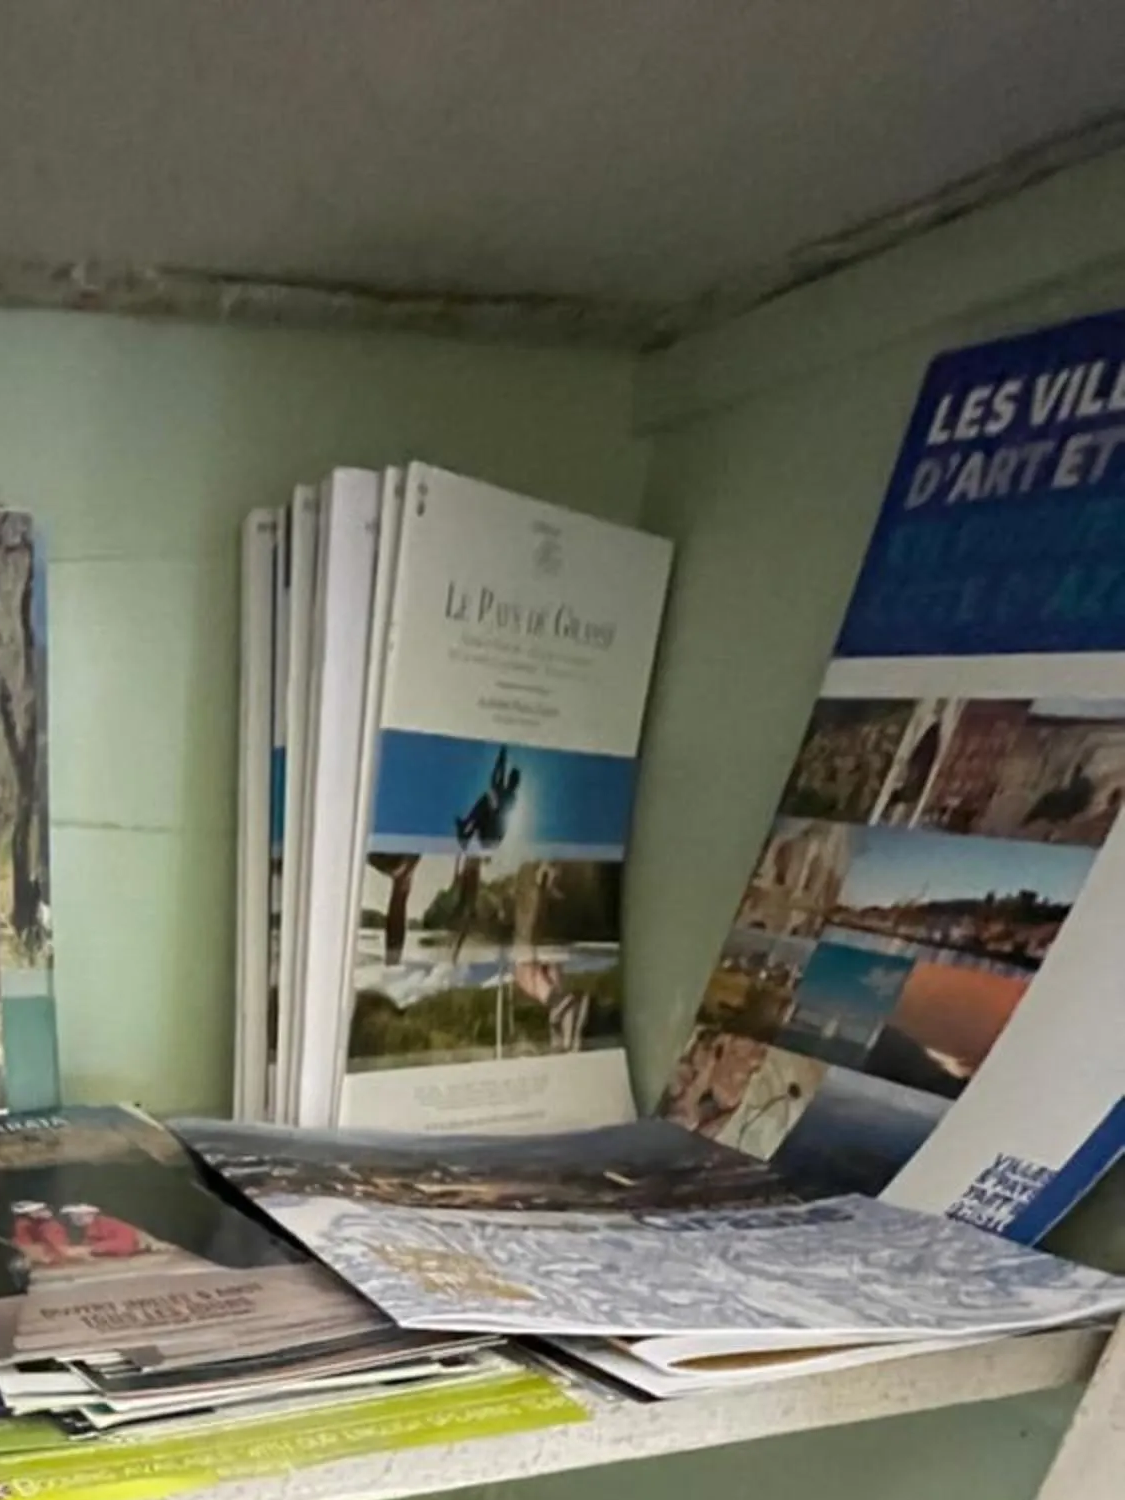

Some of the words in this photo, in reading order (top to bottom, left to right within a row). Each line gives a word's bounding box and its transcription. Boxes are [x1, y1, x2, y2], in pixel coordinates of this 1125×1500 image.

[928, 379, 1023, 446] LES
[903, 440, 1056, 512] D'ART
[1051, 424, 1125, 490] ET
